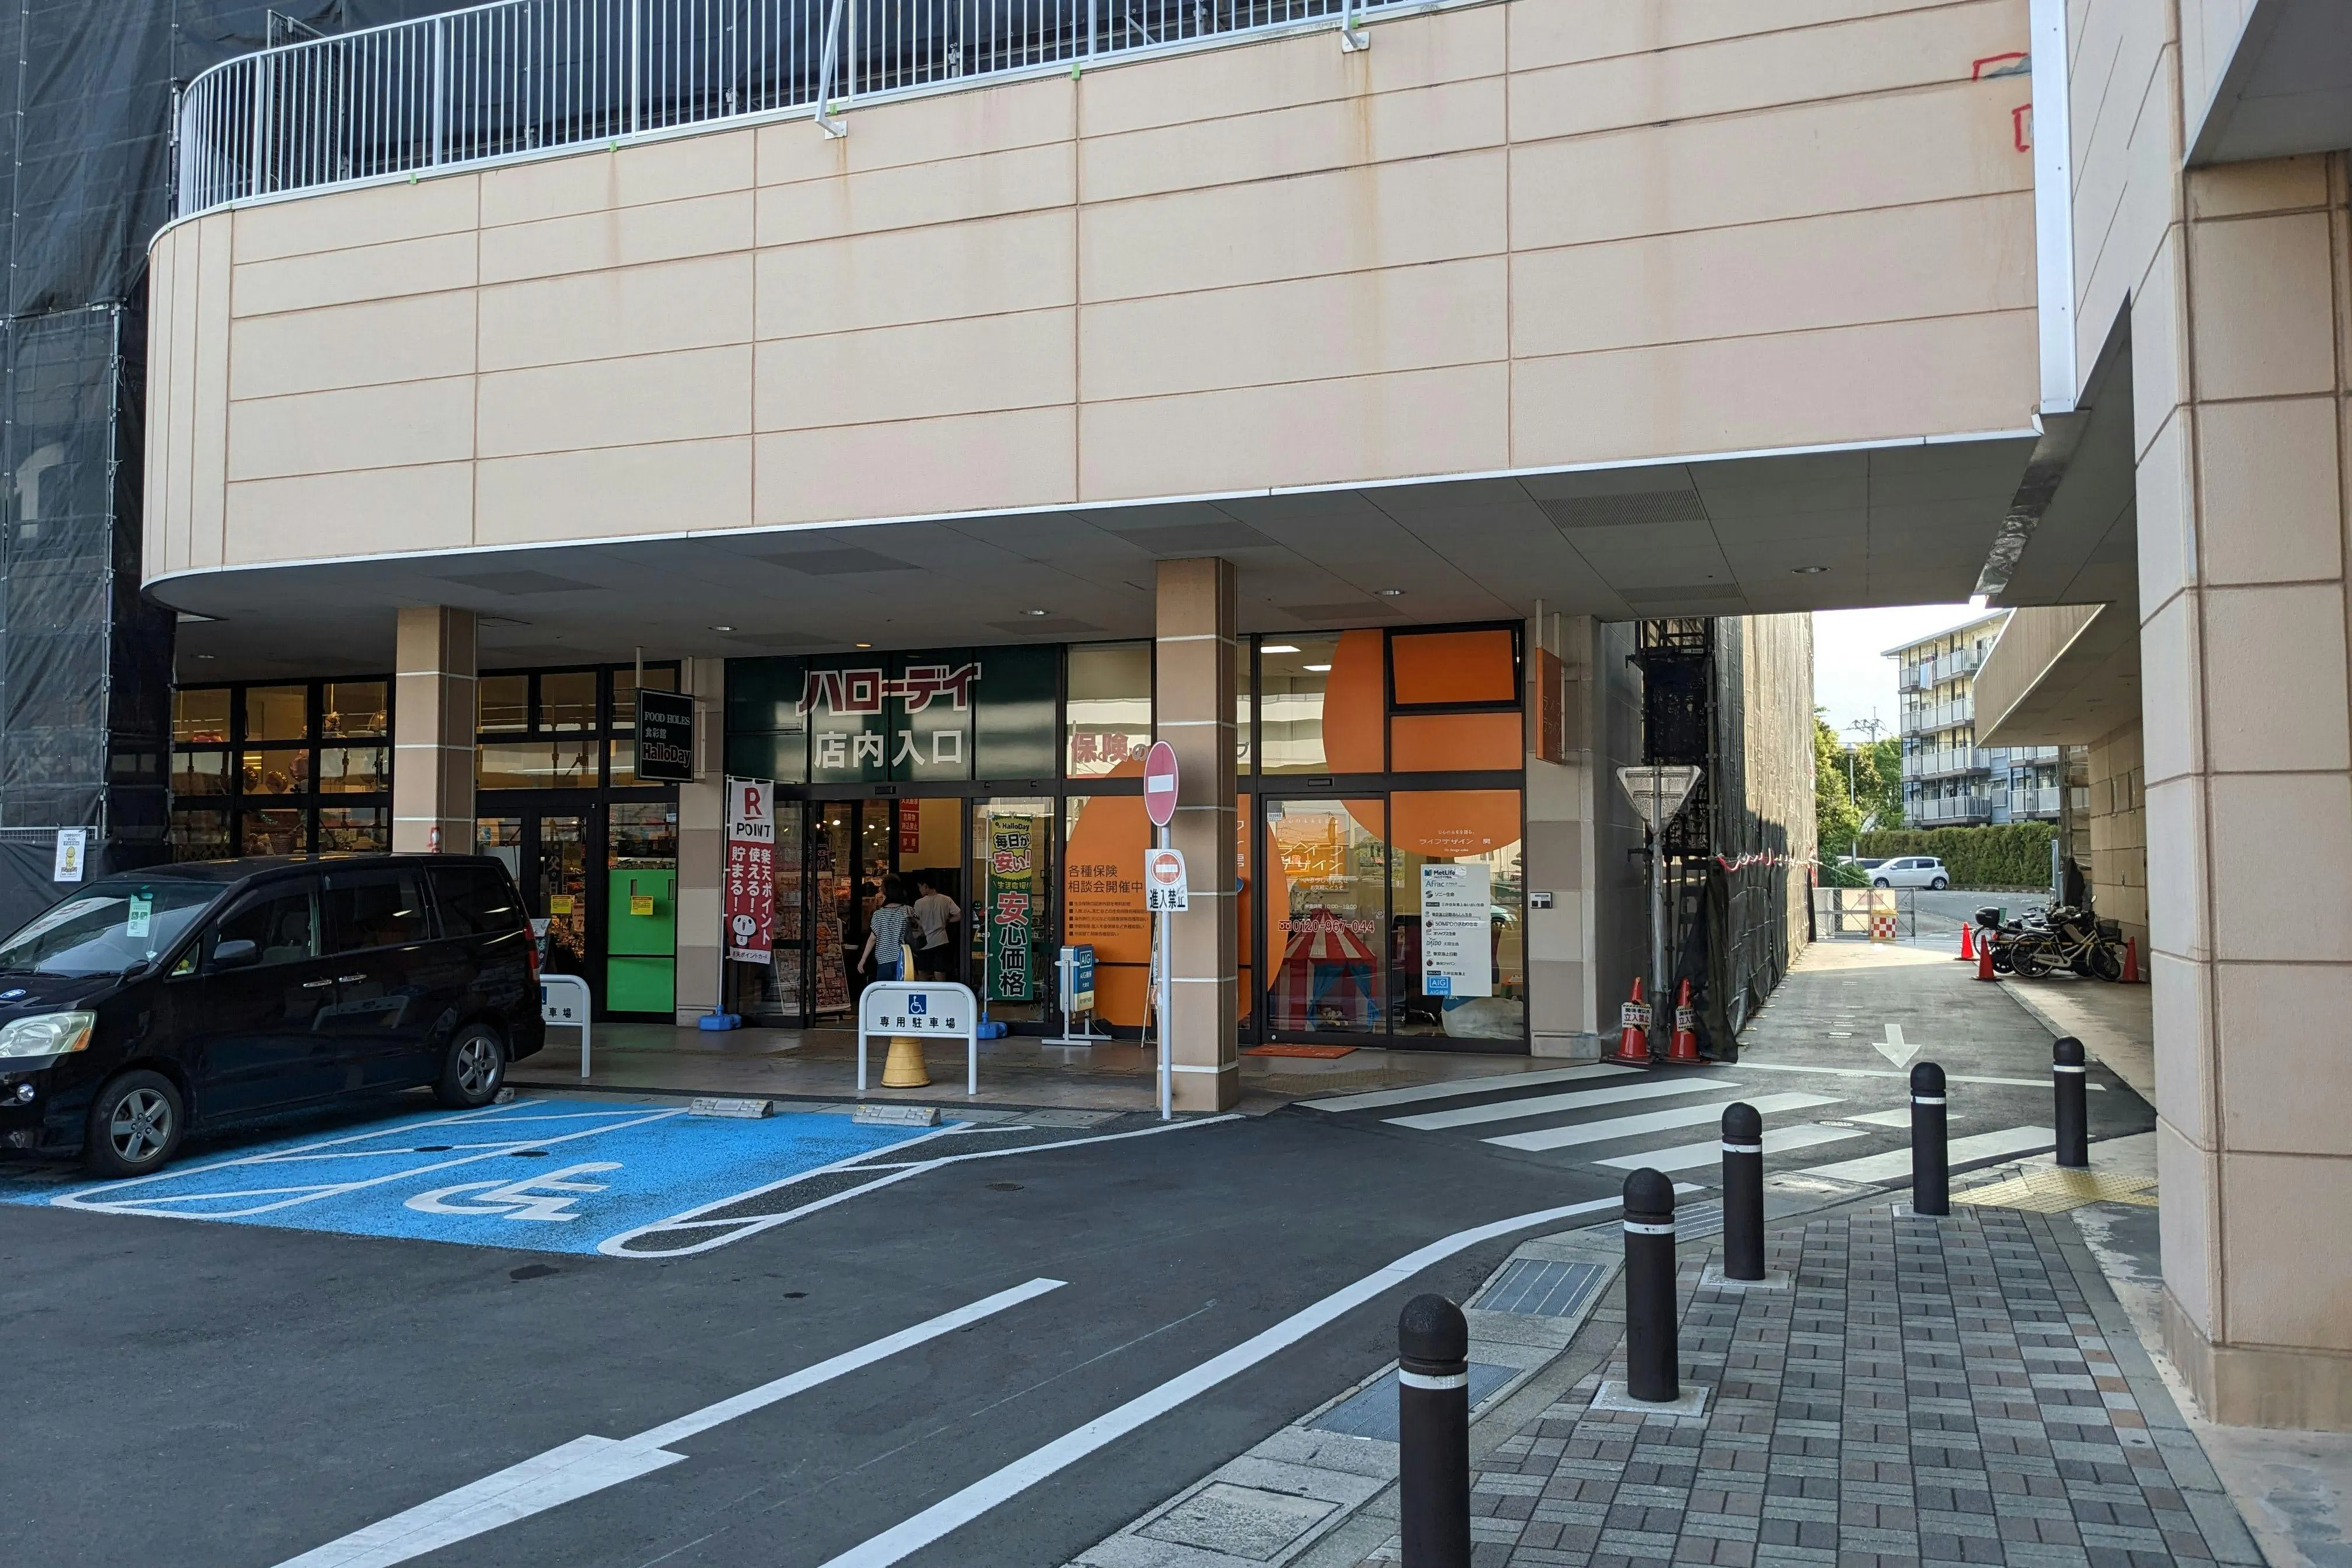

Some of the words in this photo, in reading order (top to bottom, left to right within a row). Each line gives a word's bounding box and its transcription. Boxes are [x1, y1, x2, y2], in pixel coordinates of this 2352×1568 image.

[796, 663, 982, 717] ハローデイ
[644, 712, 666, 722] FOOD
[667, 715, 690, 725] HOLES
[645, 727, 667, 739] 食彩館
[642, 743, 691, 768] HalloDay
[814, 730, 962, 768] 店内入口
[736, 822, 771, 837] POINT
[1002, 822, 1030, 831] HalloDay
[995, 832, 1030, 848] 毎日が
[1068, 864, 1118, 877] 各種保険
[1068, 880, 1143, 893] 相談会開催中
[761, 848, 772, 945] 楽天ポイント
[1150, 888, 1186, 909] 進入禁止
[1293, 919, 1374, 933] 0120-967-044
[994, 891, 1029, 997] 安心価格
[1081, 953, 1091, 965] AIG
[541, 1007, 572, 1019] 車場
[1624, 1013, 1650, 1023] 立入禁止
[880, 1016, 956, 1029] 専用駐車場
